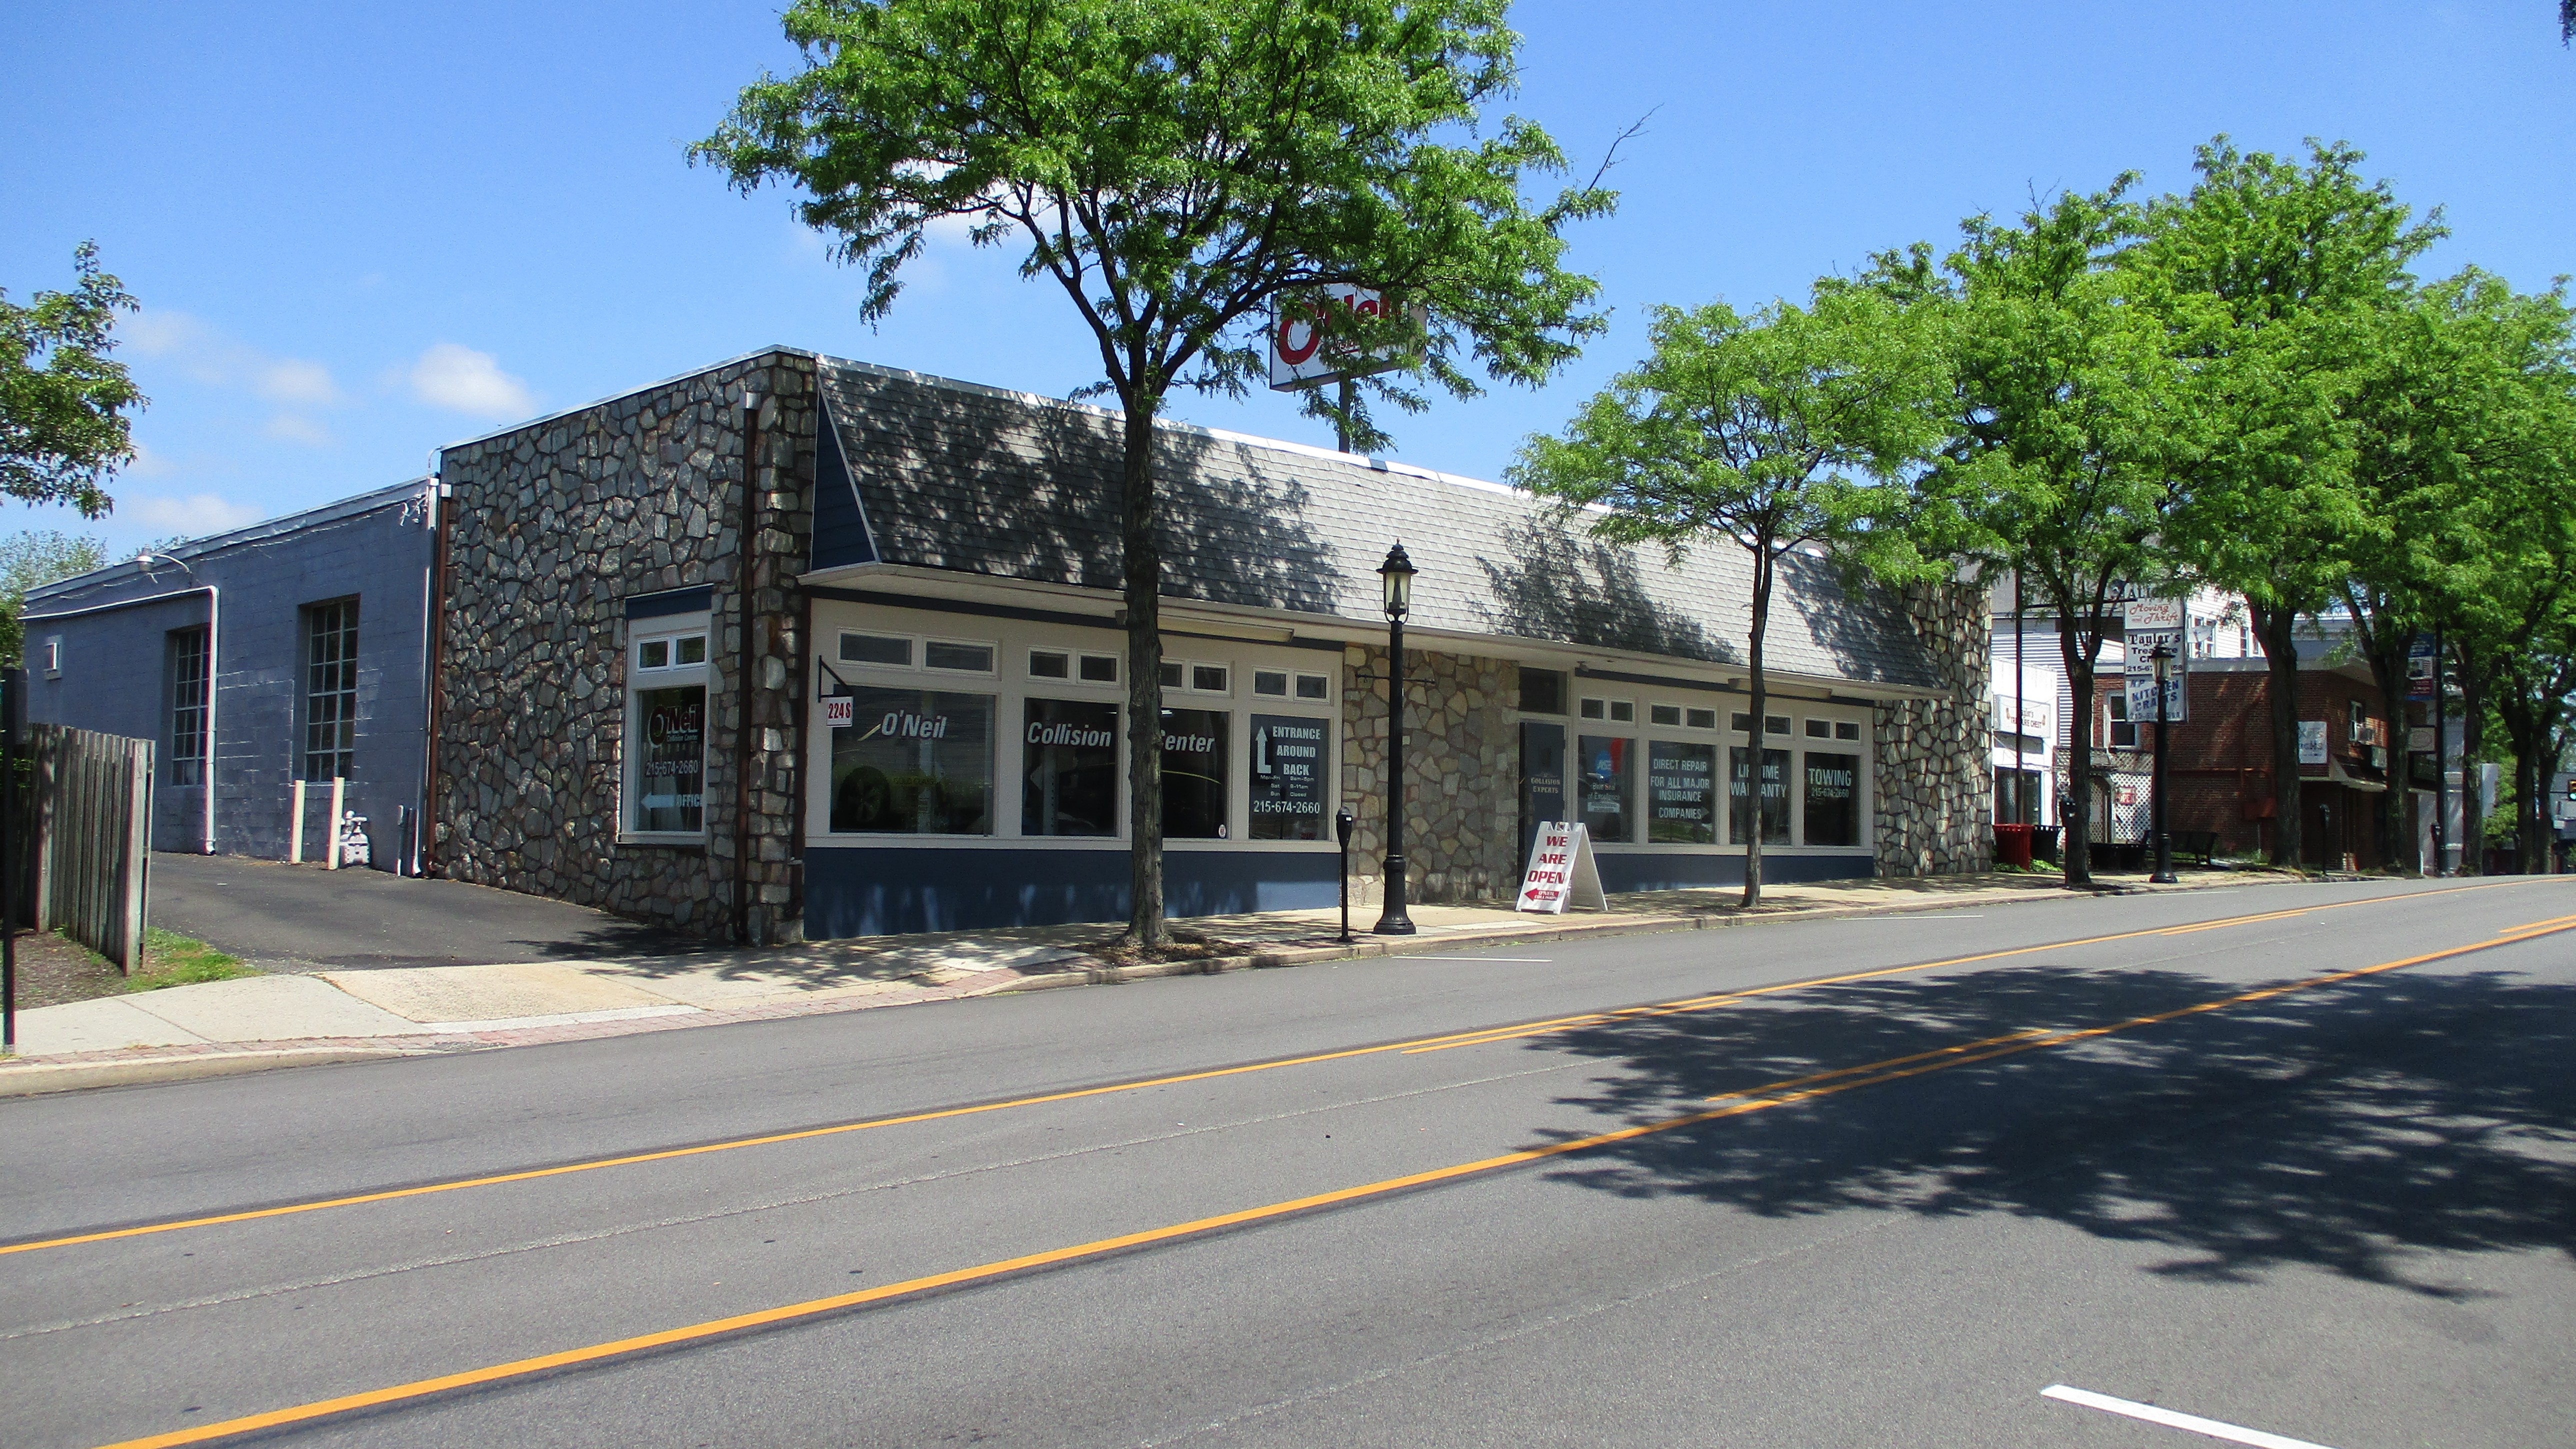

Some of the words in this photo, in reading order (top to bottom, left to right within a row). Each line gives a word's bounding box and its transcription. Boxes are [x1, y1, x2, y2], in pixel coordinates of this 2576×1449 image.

[2130, 604, 2168, 614] Moving
[2144, 612, 2178, 624] Thrift
[2132, 680, 2179, 702] KITCEN
[2136, 692, 2178, 711] CRATS
[882, 710, 948, 738] O'Neil
[1028, 722, 1112, 747] Collision
[1272, 726, 1320, 740] ENTRANCE
[1160, 729, 1215, 752] enter
[1276, 745, 1316, 758] AROUND
[646, 760, 698, 776] 215-674-2660
[1283, 764, 1310, 776] BACK
[1654, 758, 1680, 770] DIRECT
[1682, 760, 1707, 771] REPAIR
[1650, 776, 1664, 786] FOR
[1668, 777, 1681, 788] ALL
[1683, 778, 1710, 788] MAJOR
[1808, 768, 1852, 787] TOWING
[1659, 790, 1702, 802] INSURANCE
[1812, 788, 1849, 798] 215-674-2660
[1254, 800, 1320, 814] 215-674-2660
[1659, 808, 1702, 819] COMPANIES
[1546, 836, 1568, 846] WE
[1538, 854, 1568, 864] ARE
[1528, 870, 1566, 884] OPEN
